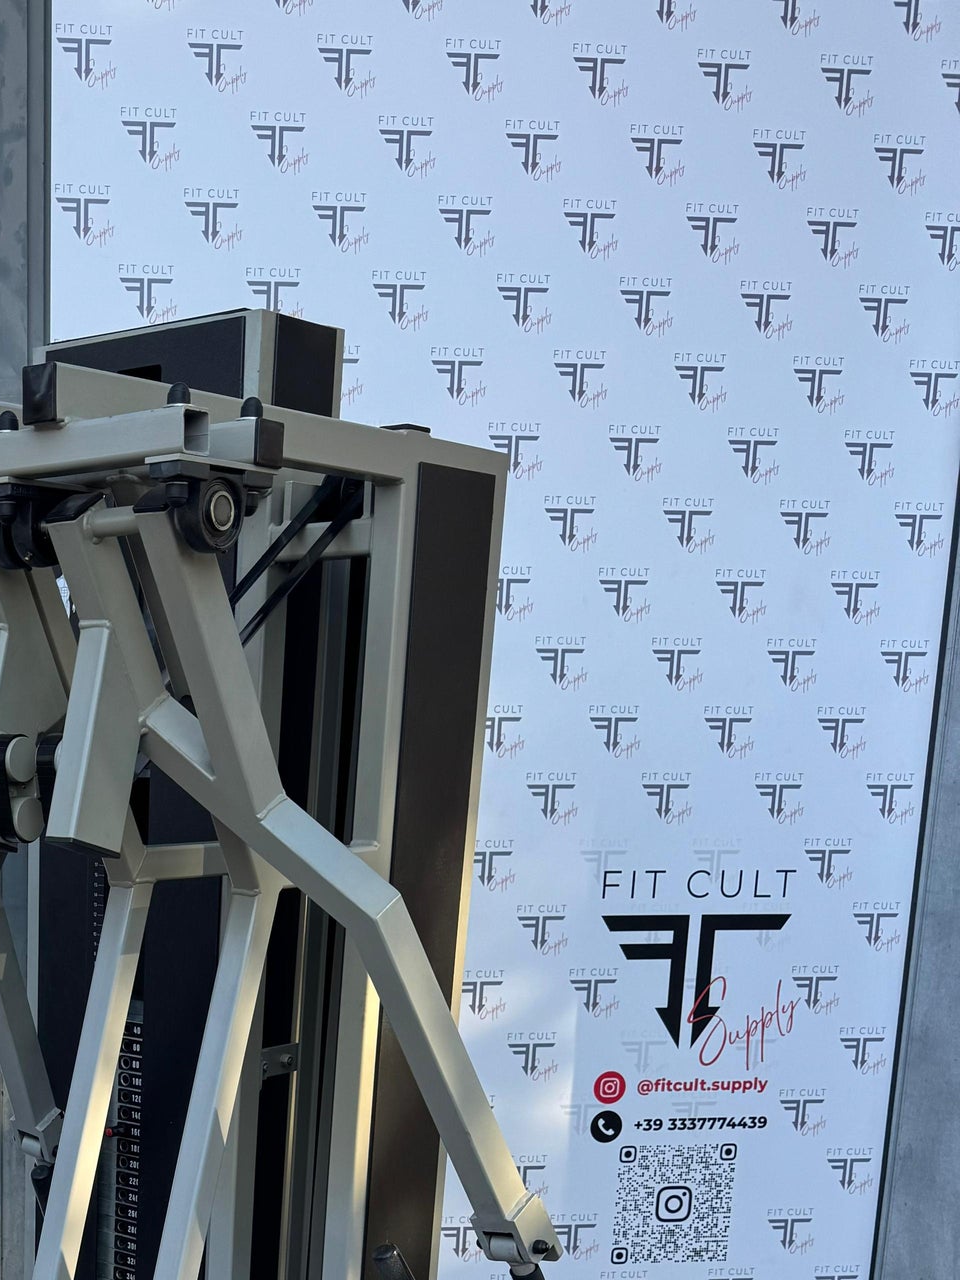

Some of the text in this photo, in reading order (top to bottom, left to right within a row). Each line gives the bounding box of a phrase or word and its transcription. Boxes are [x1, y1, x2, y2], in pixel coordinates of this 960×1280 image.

[316, 33, 374, 46] FIT CULT
[697, 48, 752, 61] FIT CULT
[504, 119, 561, 131] FIT CULT
[183, 187, 240, 199] FIT CULT
[685, 202, 740, 214] FIT CULT
[371, 270, 427, 281] FIT CULT
[619, 276, 673, 288] FIT CULT
[858, 284, 911, 296] FIT CULT
[727, 426, 779, 438] FIT CULT
[662, 497, 715, 508] FIT CULT
[894, 501, 945, 512] FIT CULT
[651, 637, 703, 647] FIT CULT
[879, 639, 930, 649] FIT CULT
[588, 704, 640, 715] FIT CULT
[641, 772, 692, 782] FIT CULT
[601, 869, 797, 900] FIT CULT
[516, 904, 567, 913] FIT CULT
[852, 901, 901, 911] FIT CULT
[686, 975, 801, 1072] Supply
[507, 1031, 557, 1041] FIT CULT
[637, 1077, 768, 1096] @fitcult.supply
[633, 1116, 767, 1132] +39 3337774439
